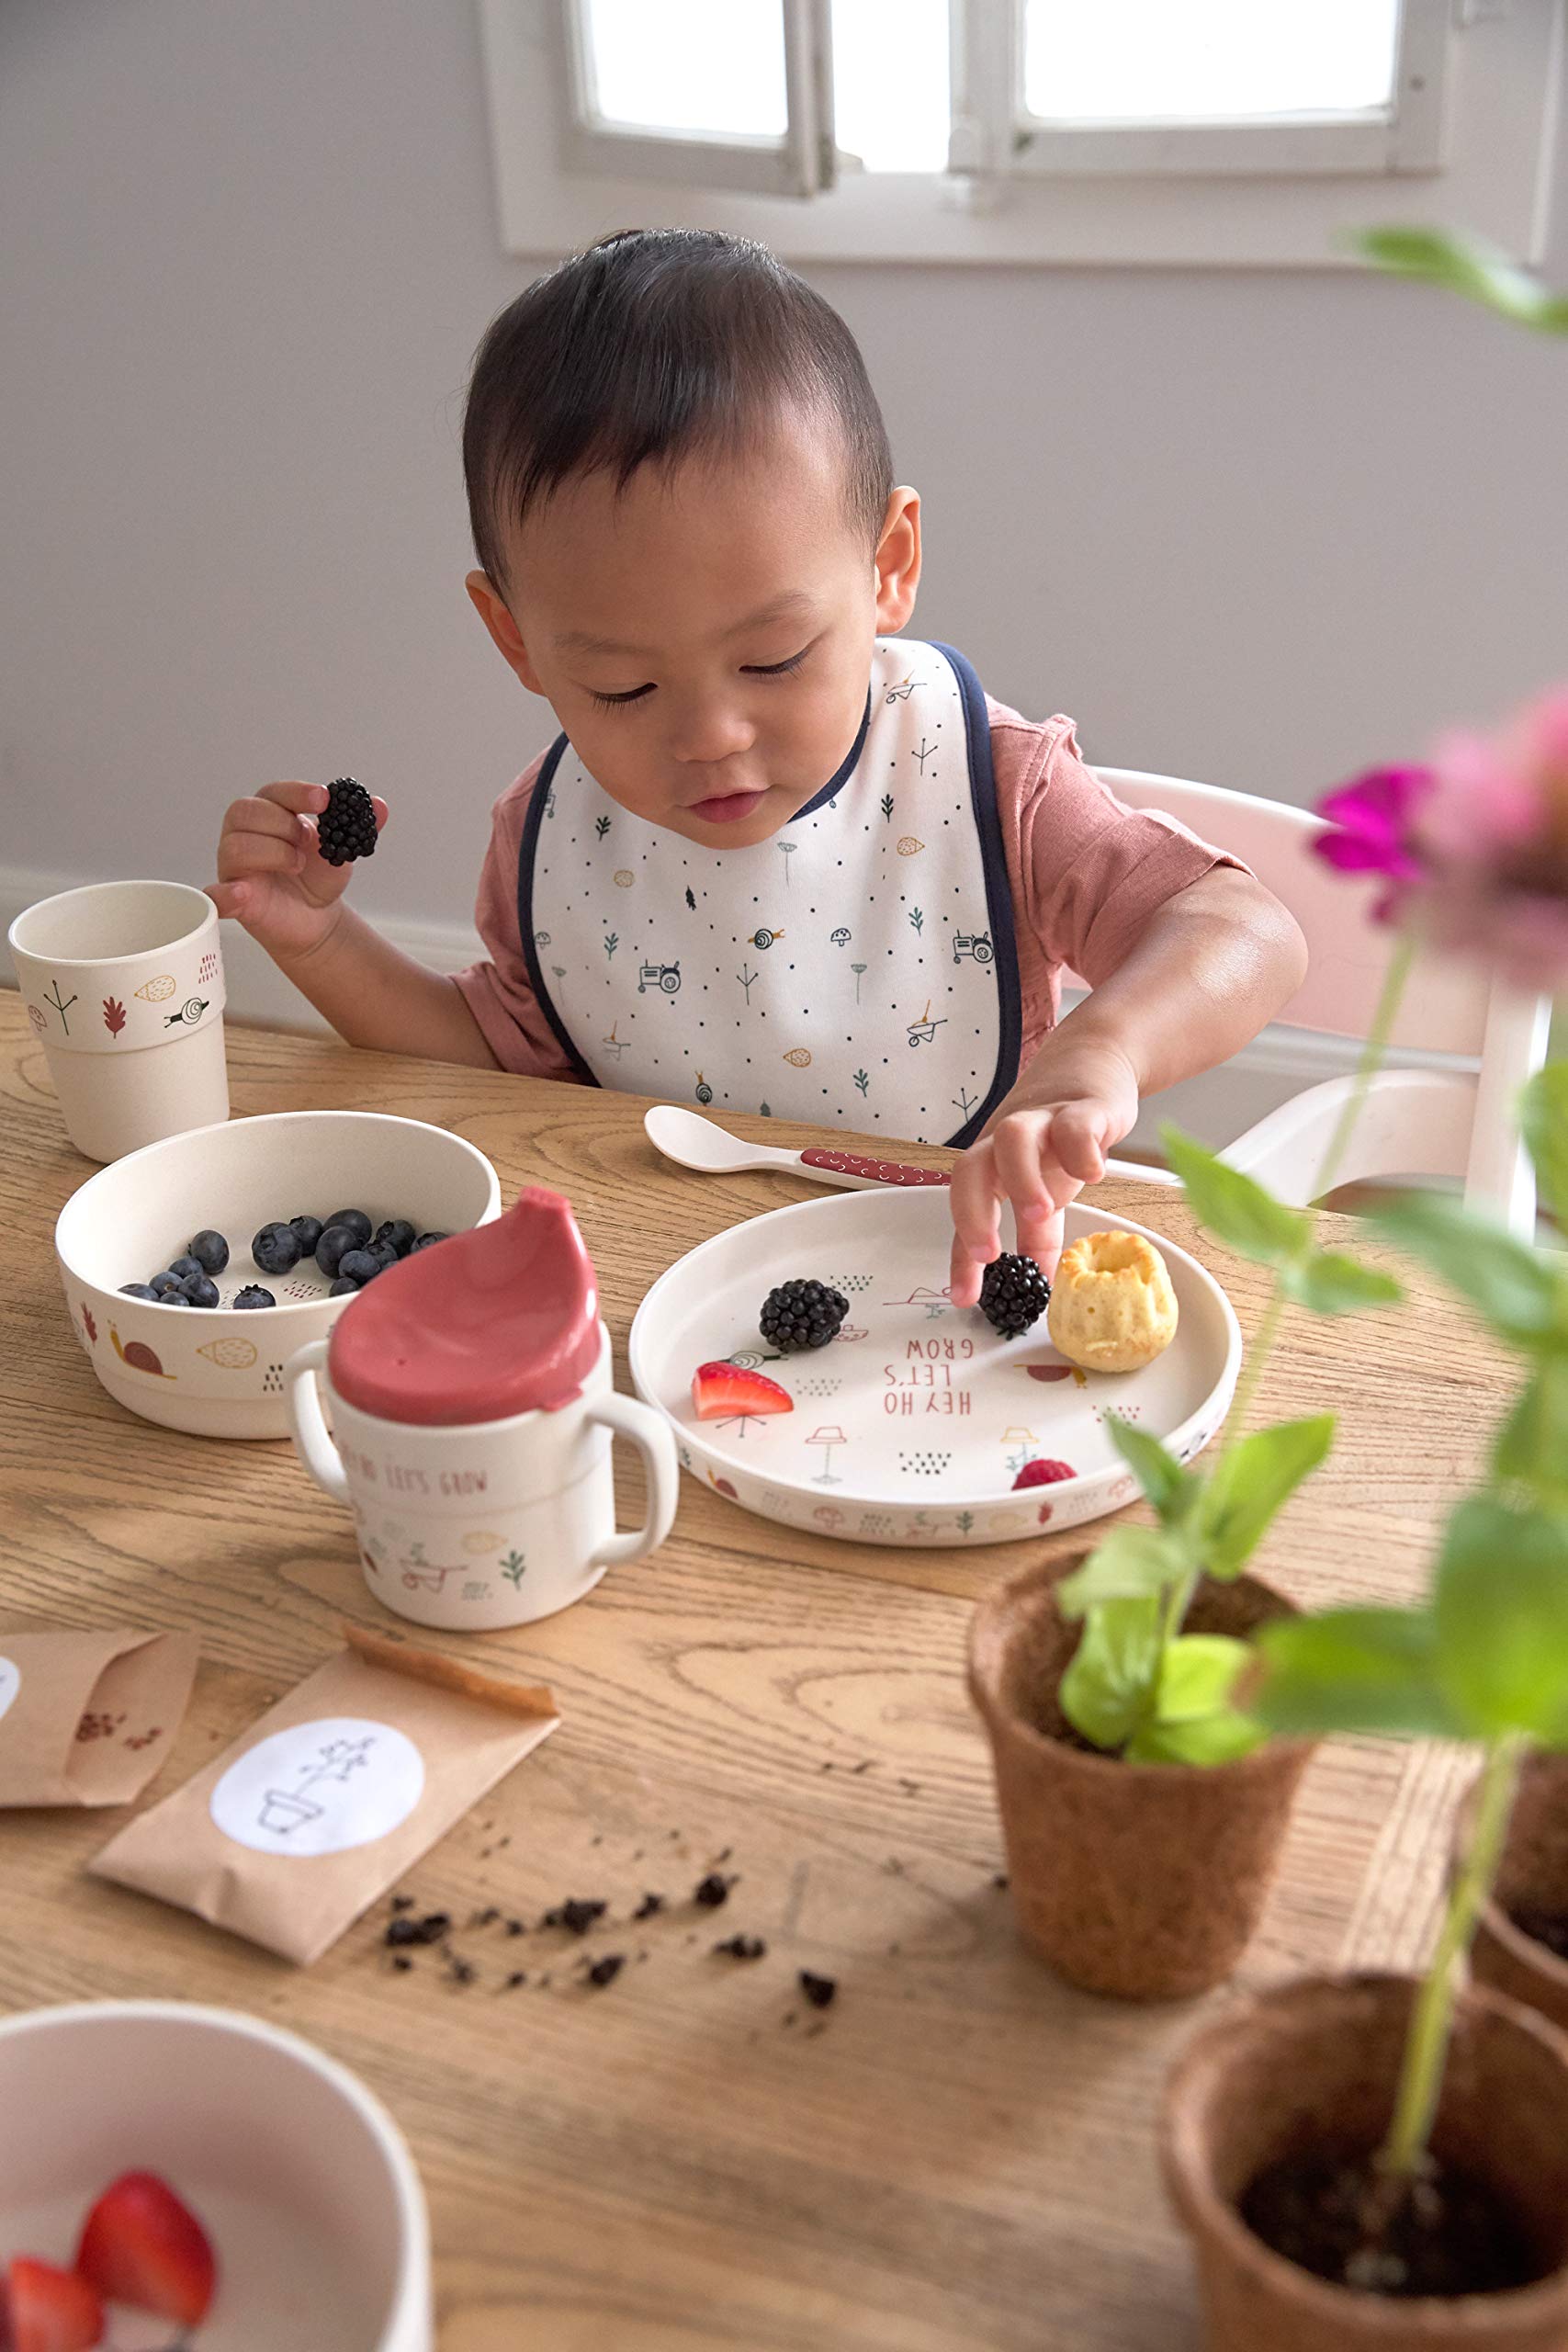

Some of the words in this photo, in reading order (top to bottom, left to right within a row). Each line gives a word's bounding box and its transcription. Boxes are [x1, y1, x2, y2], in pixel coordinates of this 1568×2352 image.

[906, 1338, 974, 1360] GROW
[884, 1364, 951, 1386] LET'S
[884, 1392, 913, 1416] HO
[926, 1392, 971, 1415] HEY
